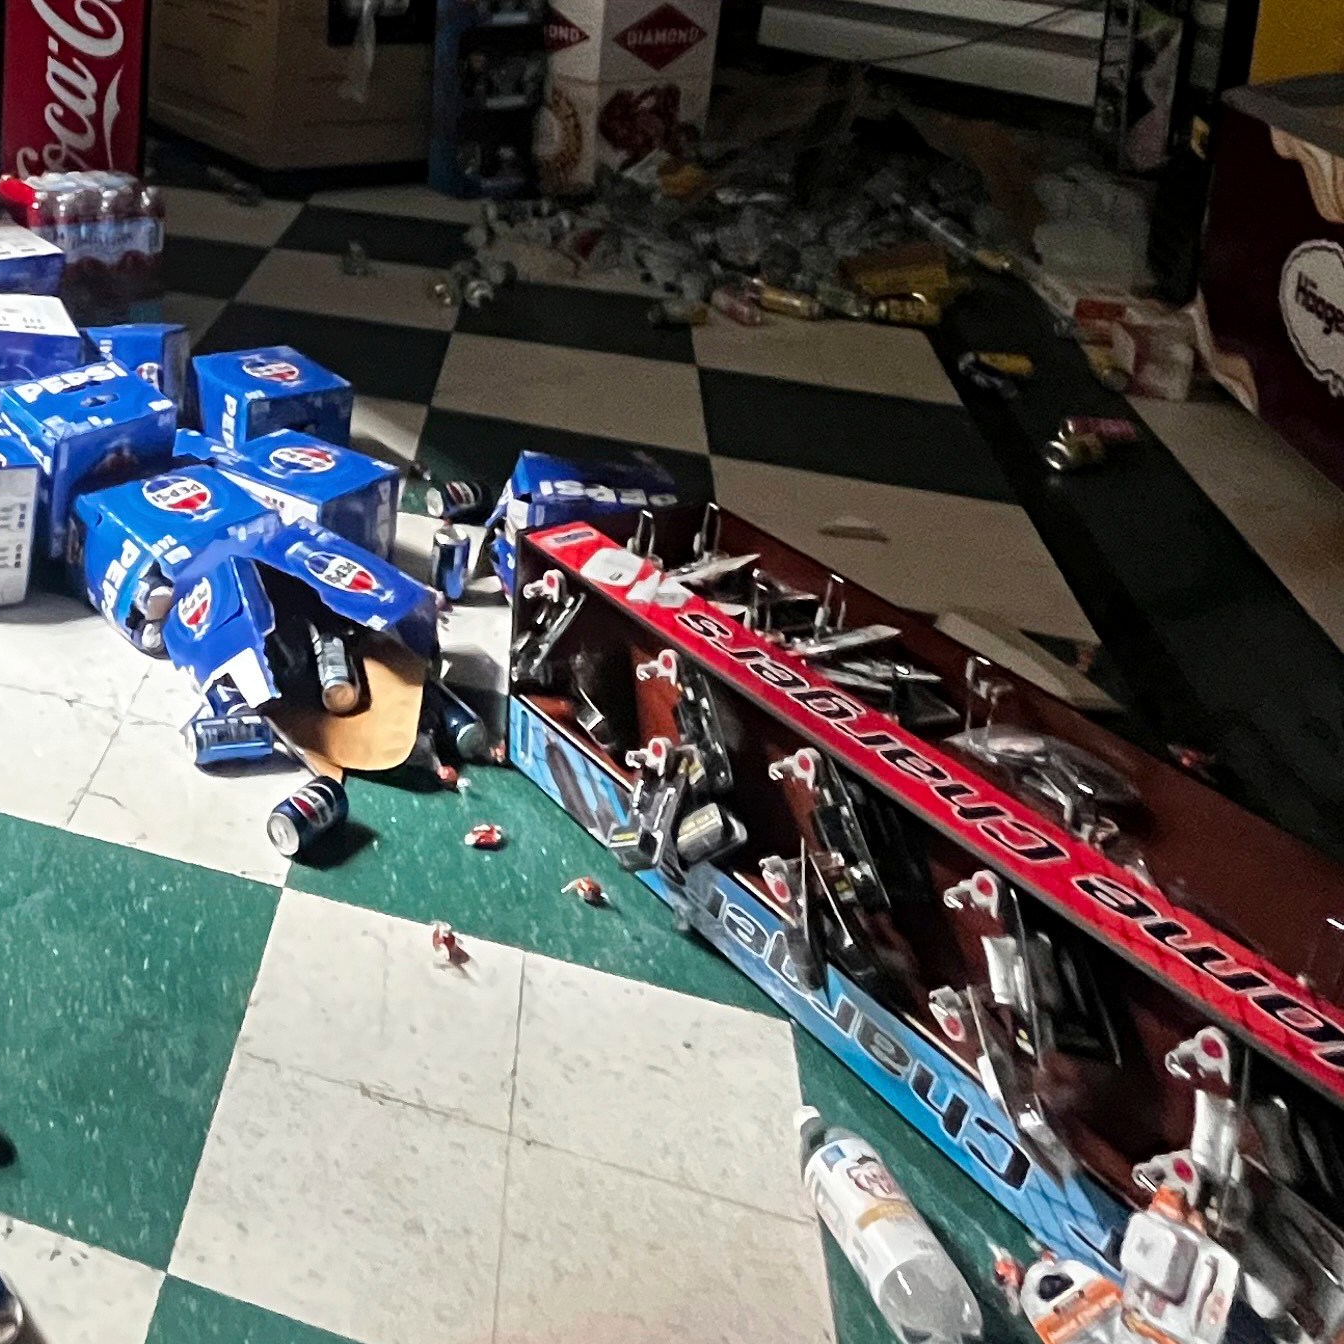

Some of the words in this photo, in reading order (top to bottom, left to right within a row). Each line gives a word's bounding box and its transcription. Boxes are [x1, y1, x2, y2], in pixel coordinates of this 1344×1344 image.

[627, 27, 700, 46] DIAMOND
[13, 361, 129, 404] PEPSI
[154, 483, 203, 504] PEPSI
[540, 480, 678, 506] PEPSI
[678, 612, 1069, 861] Chargers
[1073, 875, 1344, 1067] ome
[666, 864, 1034, 1193] Charger
